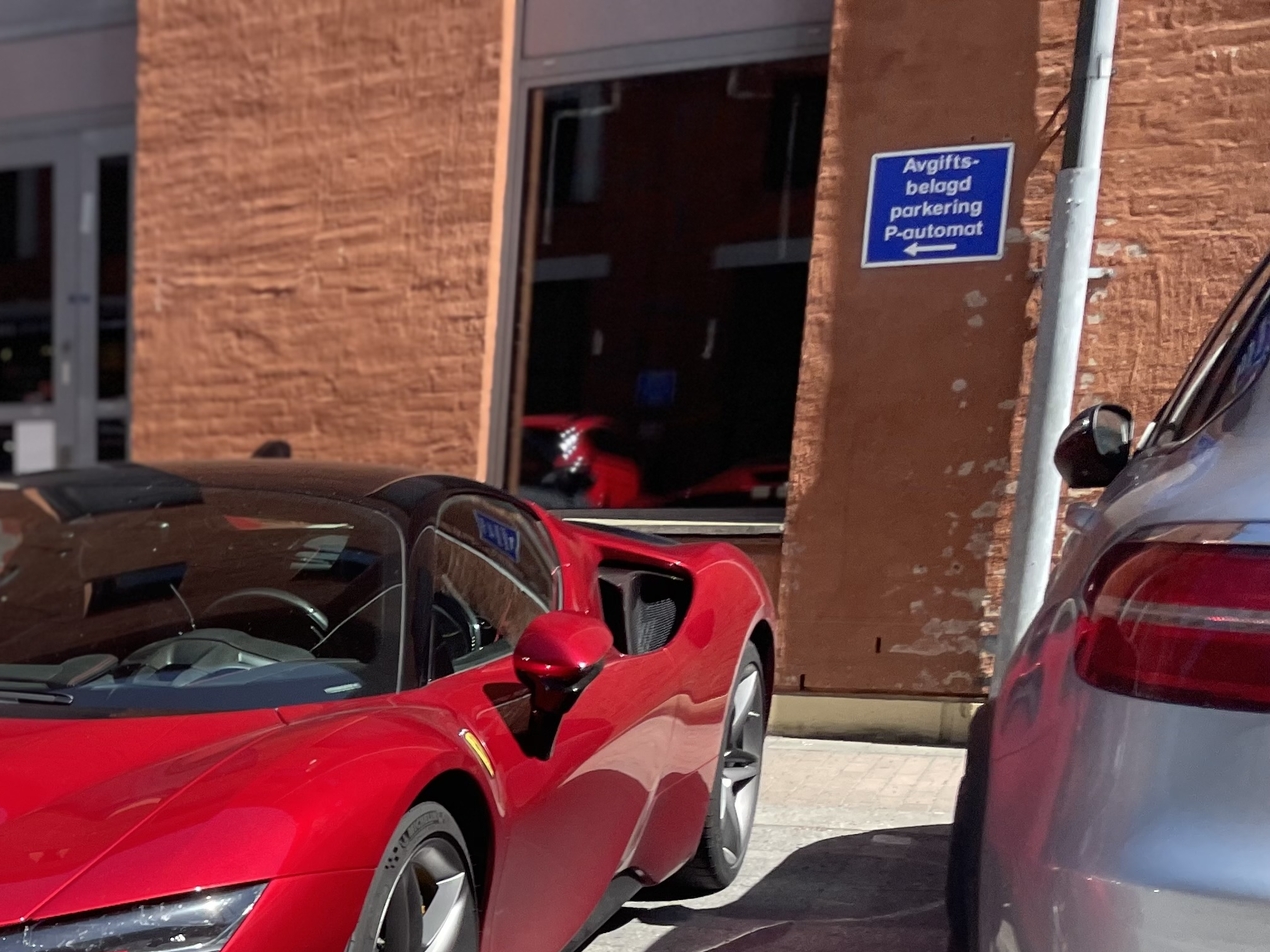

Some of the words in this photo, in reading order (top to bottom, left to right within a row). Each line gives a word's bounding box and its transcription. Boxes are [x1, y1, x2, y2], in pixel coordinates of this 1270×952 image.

[902, 153, 980, 175] Avgifts-
[905, 175, 972, 196] belagd
[889, 199, 983, 223] parkering
[884, 220, 983, 241] P-automat
